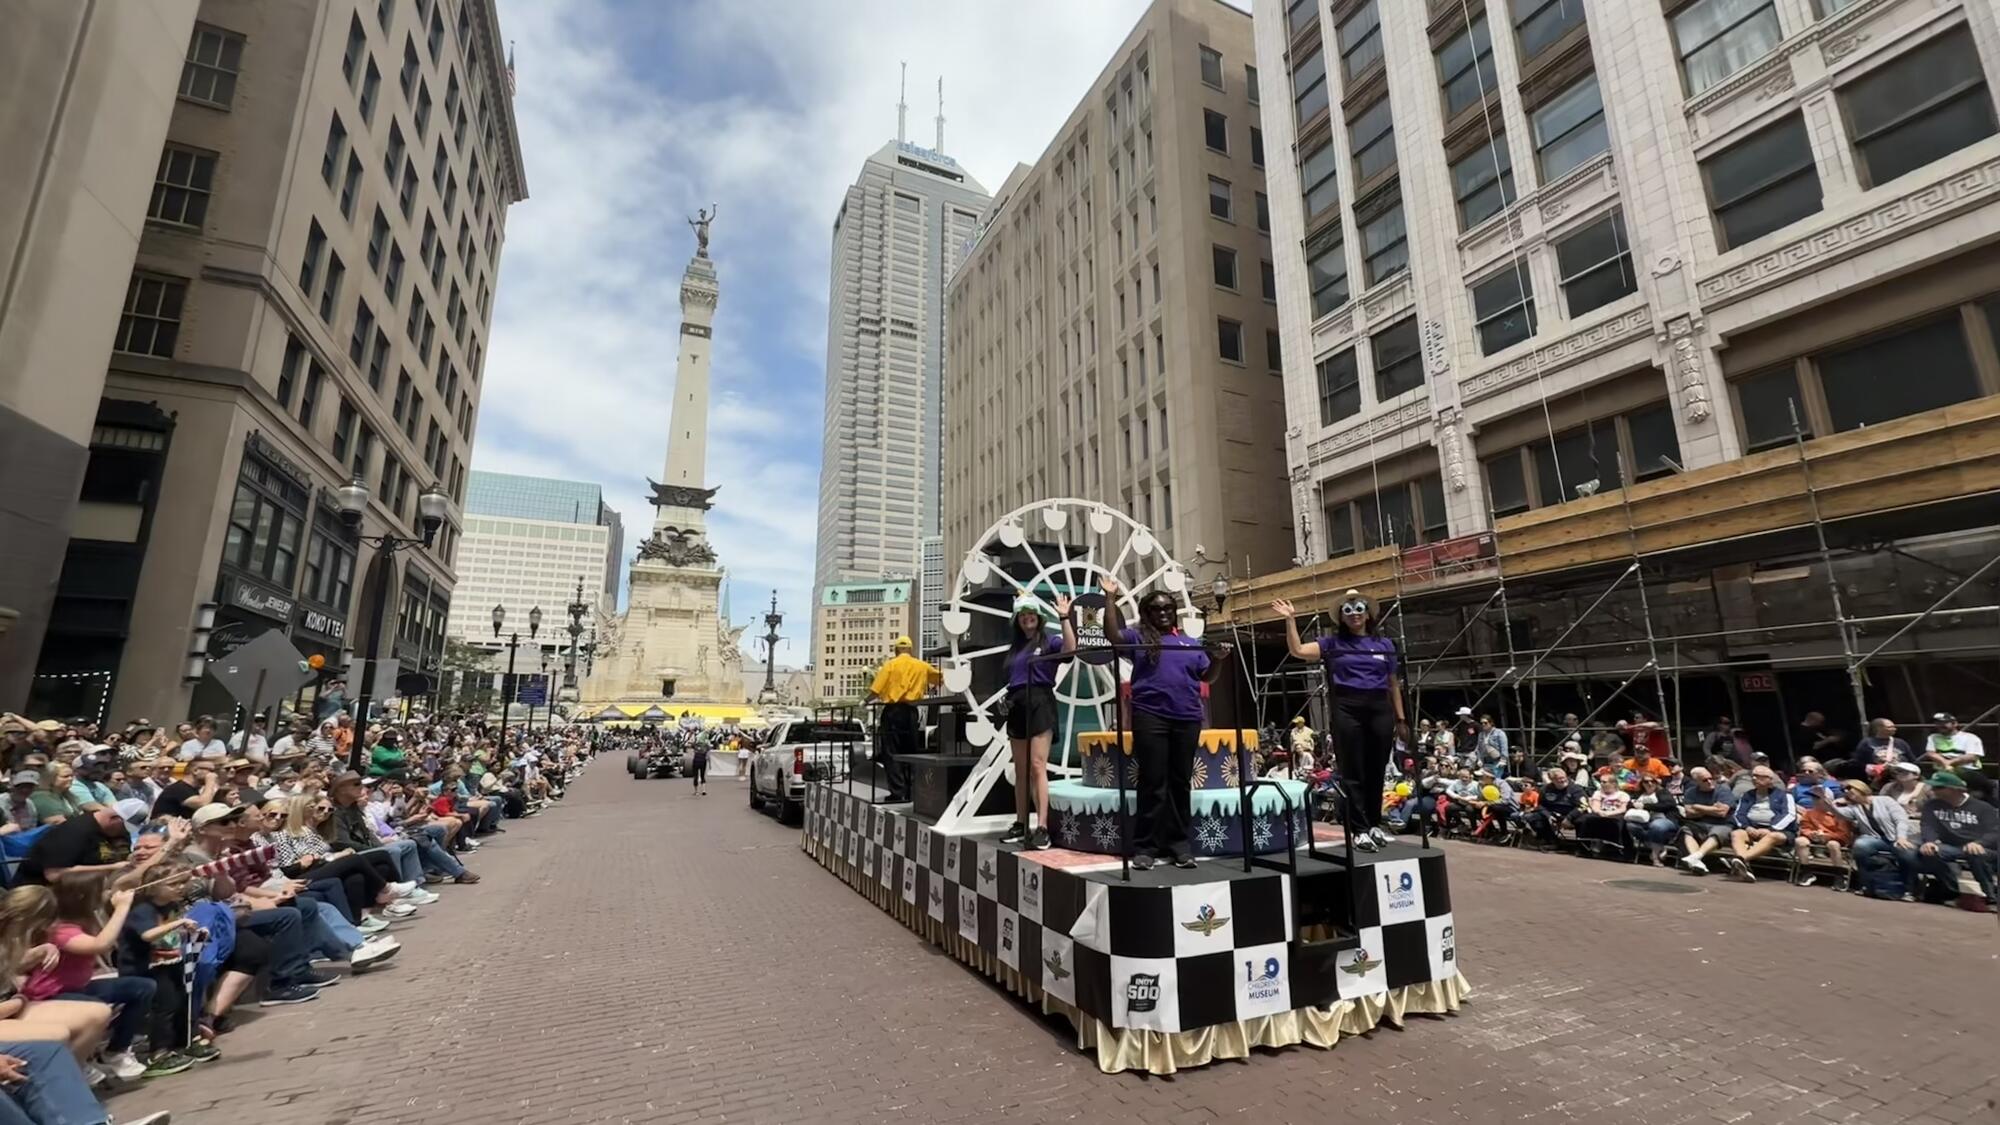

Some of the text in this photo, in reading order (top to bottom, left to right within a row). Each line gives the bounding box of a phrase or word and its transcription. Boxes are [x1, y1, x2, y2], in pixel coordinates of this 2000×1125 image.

[305, 609, 327, 633] KOKO
[1135, 977, 1156, 986] INDY
[1128, 984, 1160, 1001] 500
[1249, 988, 1279, 1000] MUSEUM
